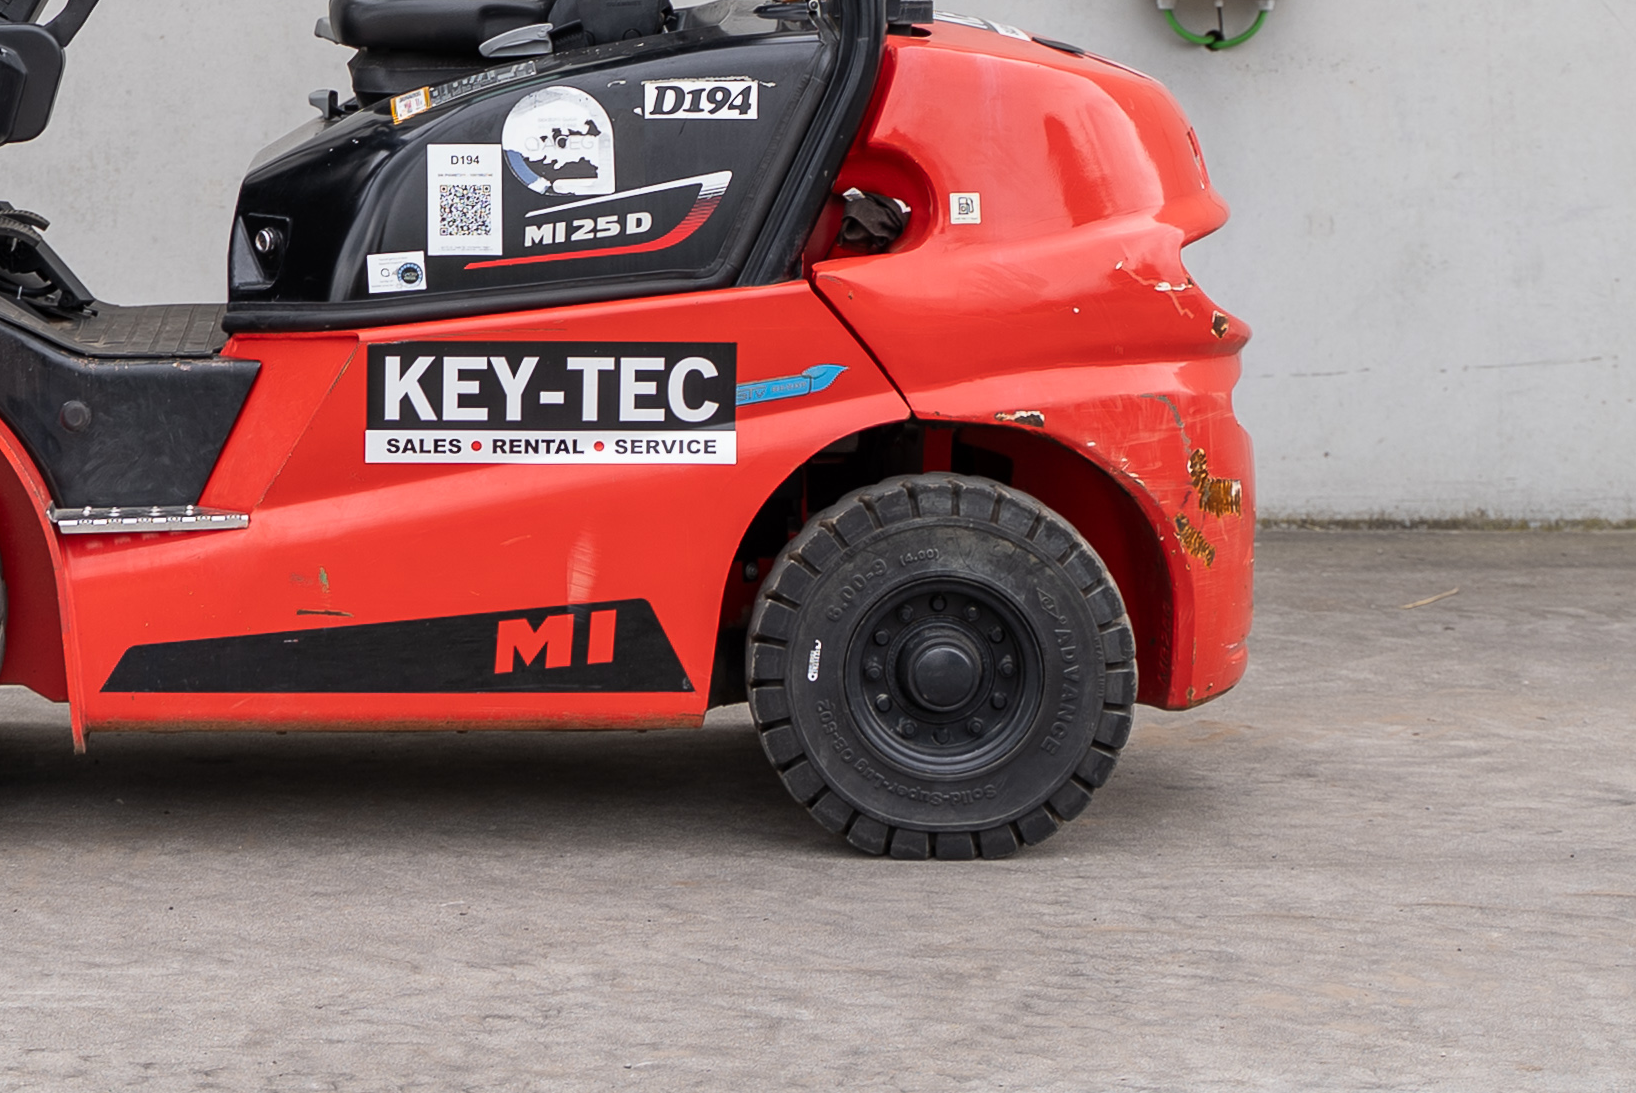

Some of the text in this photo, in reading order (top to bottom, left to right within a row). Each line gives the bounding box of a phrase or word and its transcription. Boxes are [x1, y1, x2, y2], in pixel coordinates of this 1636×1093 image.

[649, 85, 752, 115] D194
[450, 155, 480, 165] D194
[524, 211, 652, 247] MI 25 D
[384, 356, 719, 422] KEY-TEC
[386, 438, 717, 454] SALES RENTAL SERVICE
[825, 547, 940, 623] 6.00-9 (4.00)
[494, 609, 617, 674] MI
[1039, 625, 1079, 755] ADVANCE
